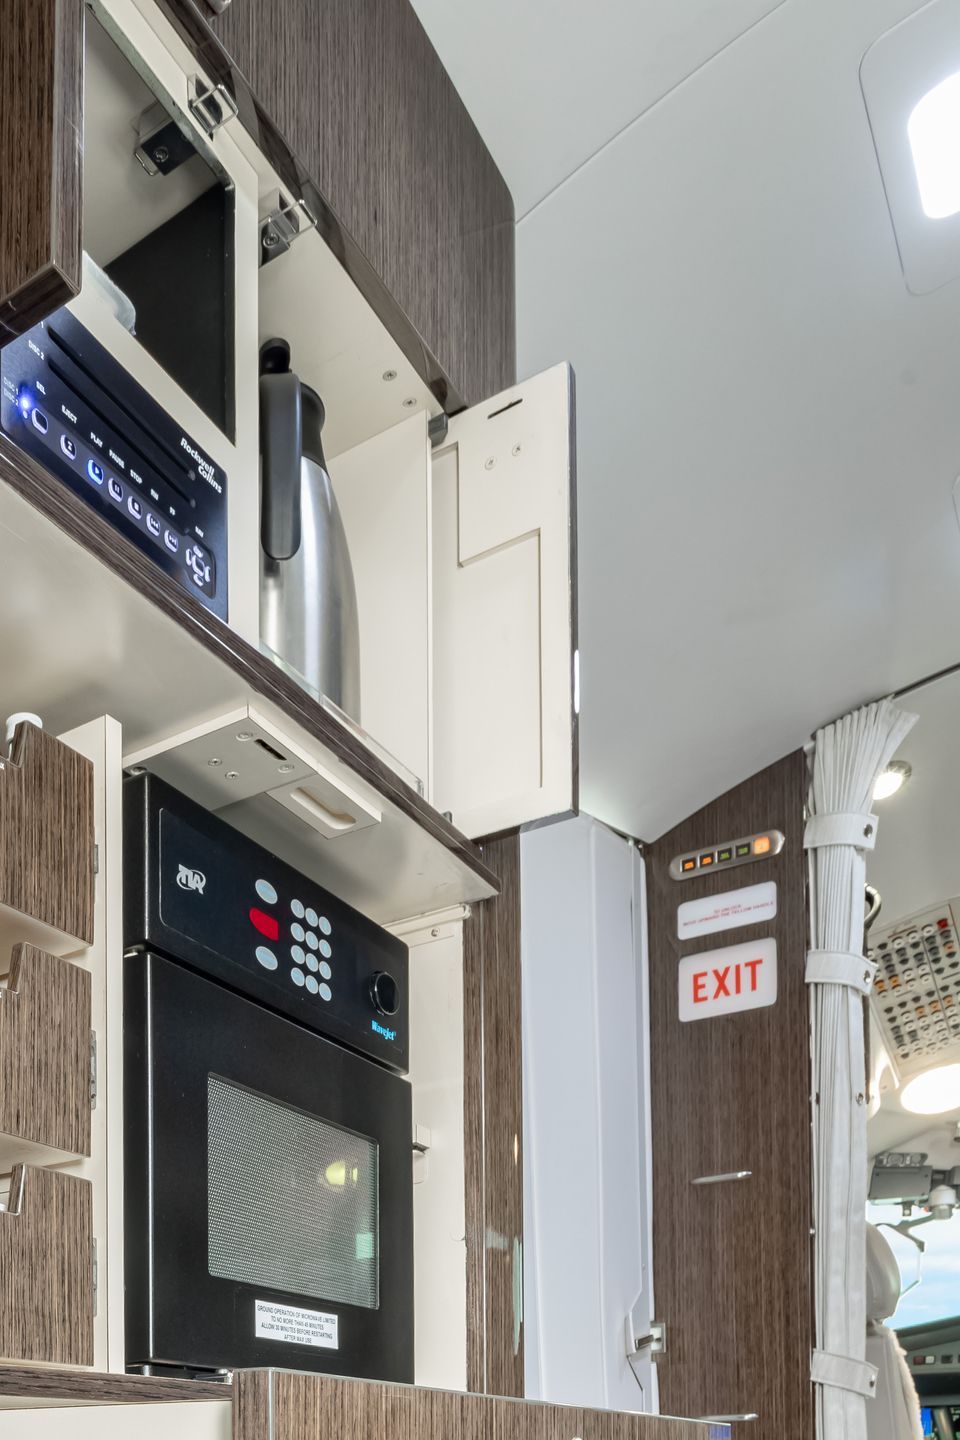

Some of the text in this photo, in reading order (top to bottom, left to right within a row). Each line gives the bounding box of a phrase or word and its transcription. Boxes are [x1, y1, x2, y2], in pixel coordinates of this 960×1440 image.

[28, 339, 45, 361] DISC 2
[36, 381, 46, 395] SEL
[61, 404, 78, 424] EJECT
[90, 432, 103, 448] PLAY
[109, 449, 125, 469] PAUSE
[180, 437, 215, 476] Rockwell
[130, 469, 142, 484] STOP
[198, 465, 222, 494] Collins
[693, 959, 763, 1004] EXIT
[257, 1304, 274, 1314] GROUND
[274, 1308, 295, 1317] OPERATION
[301, 1313, 323, 1323] MICROWAVE
[271, 1315, 277, 1323] TO
[309, 1322, 324, 1330] MINUTES
[261, 1322, 275, 1330] ALLOW
[280, 1325, 296, 1334] MINUTES
[296, 1328, 311, 1336] BEFORE
[311, 1330, 333, 1340] RESTARTING
